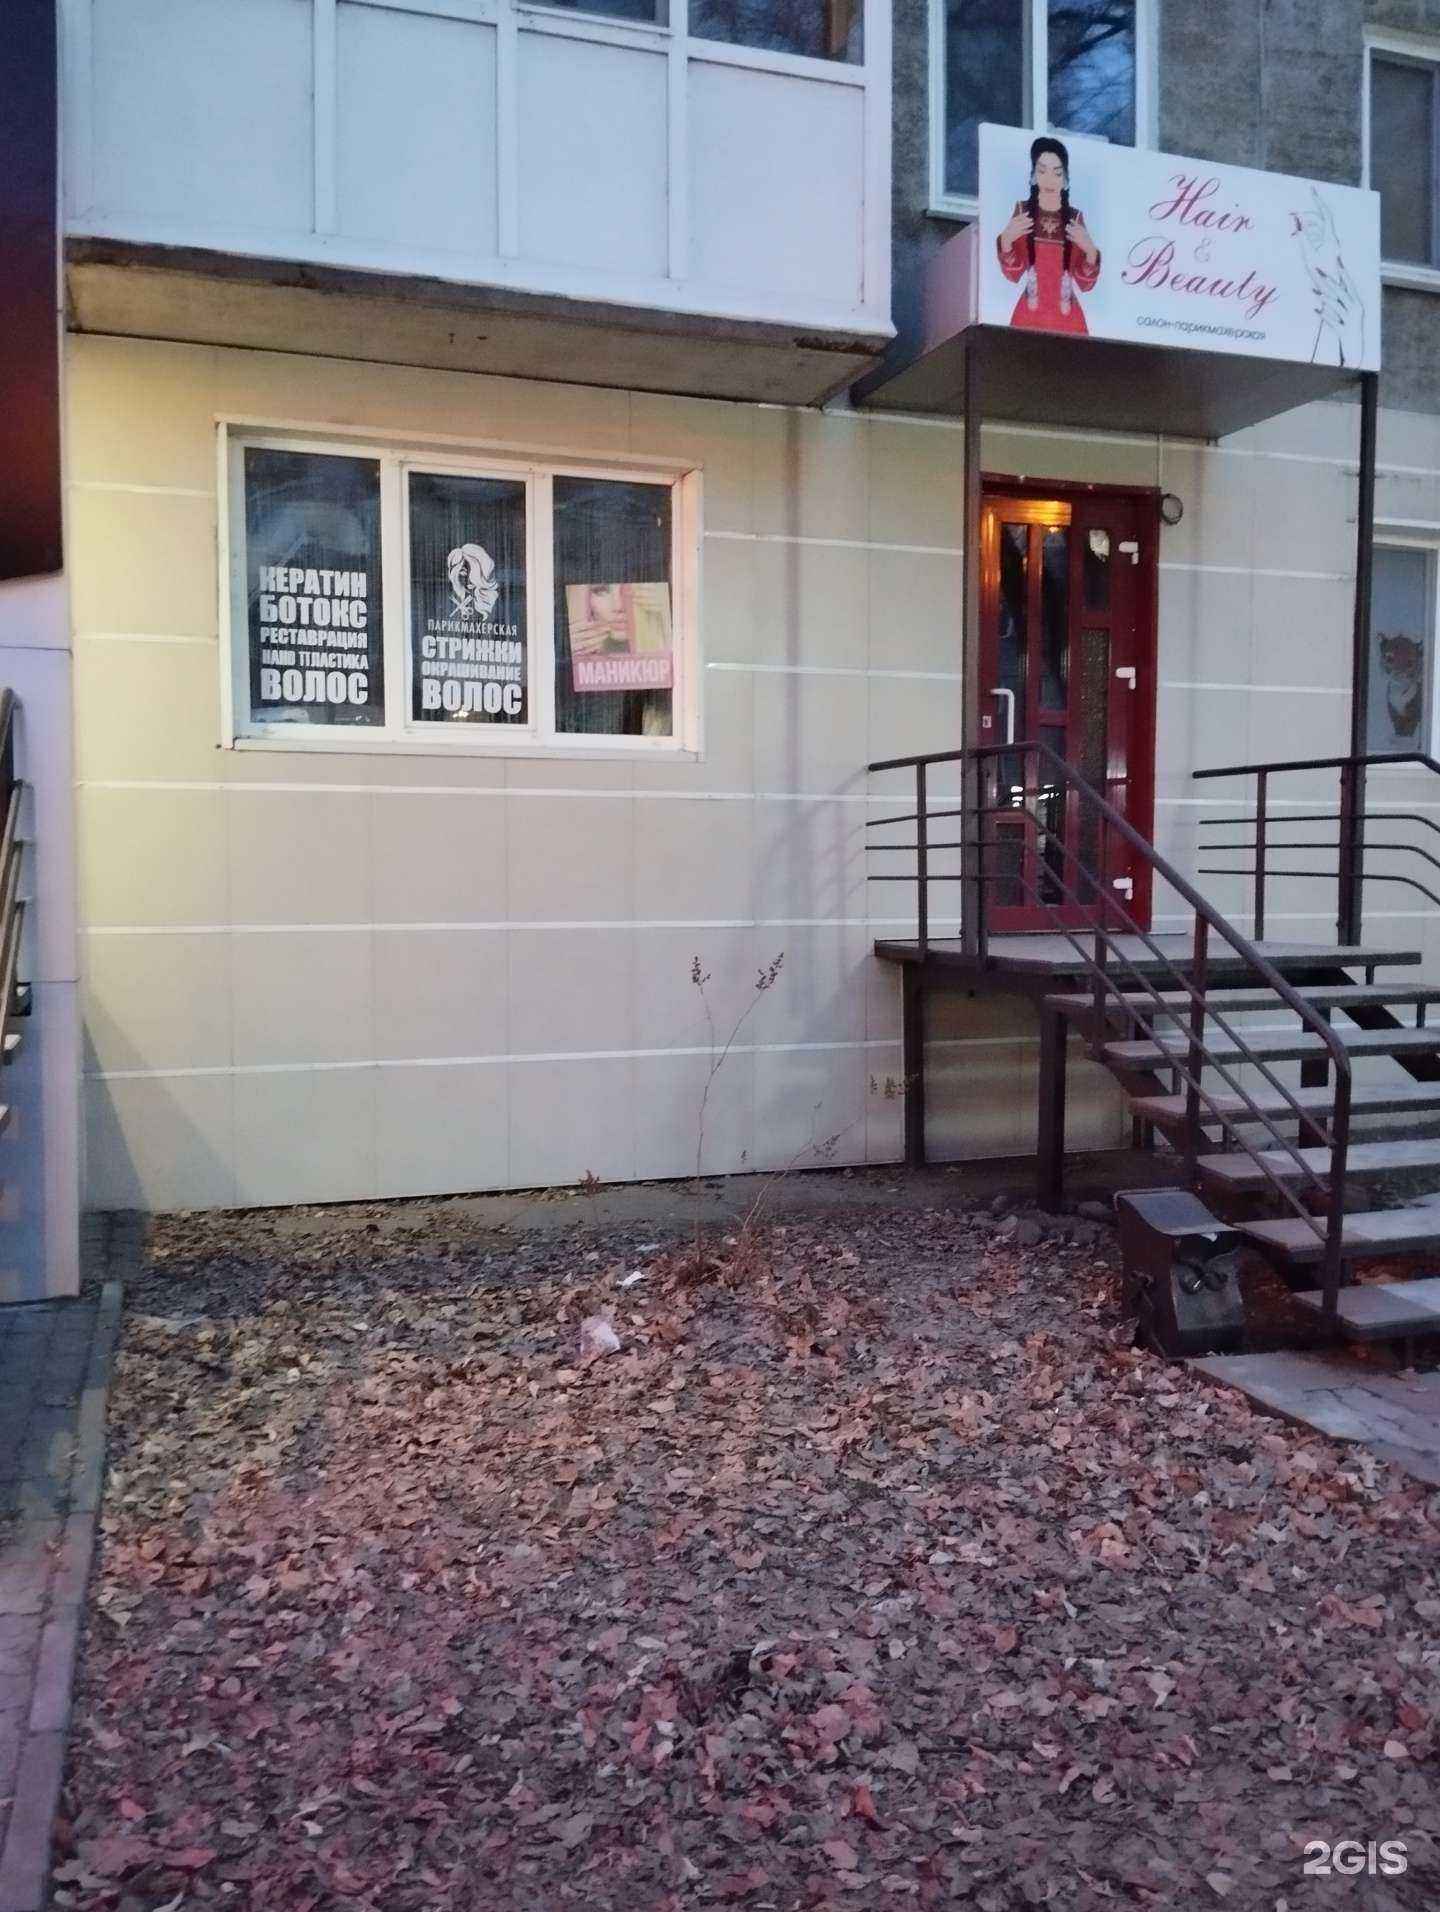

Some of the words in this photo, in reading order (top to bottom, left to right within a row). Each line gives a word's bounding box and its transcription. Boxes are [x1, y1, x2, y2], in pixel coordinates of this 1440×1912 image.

[1149, 174, 1255, 233] Hair
[1194, 237, 1213, 263] &
[1121, 235, 1280, 320] Beauty
[260, 566, 367, 598] КЕРАТИН
[260, 594, 368, 628] БОТОКС
[260, 627, 368, 650] РЕСТАВРАЦИЯ
[427, 618, 518, 636] ПАРИКМАХЕРСКАЯ
[298, 651, 369, 670] ПЛАСТИКА
[422, 635, 522, 664] СТРИЖКИ
[422, 660, 521, 681] ОКРАШИВАНИЕ
[578, 659, 670, 685] МАНИКЮР
[260, 668, 369, 705] ВОЛОС
[422, 678, 522, 715] ВОЛОС
